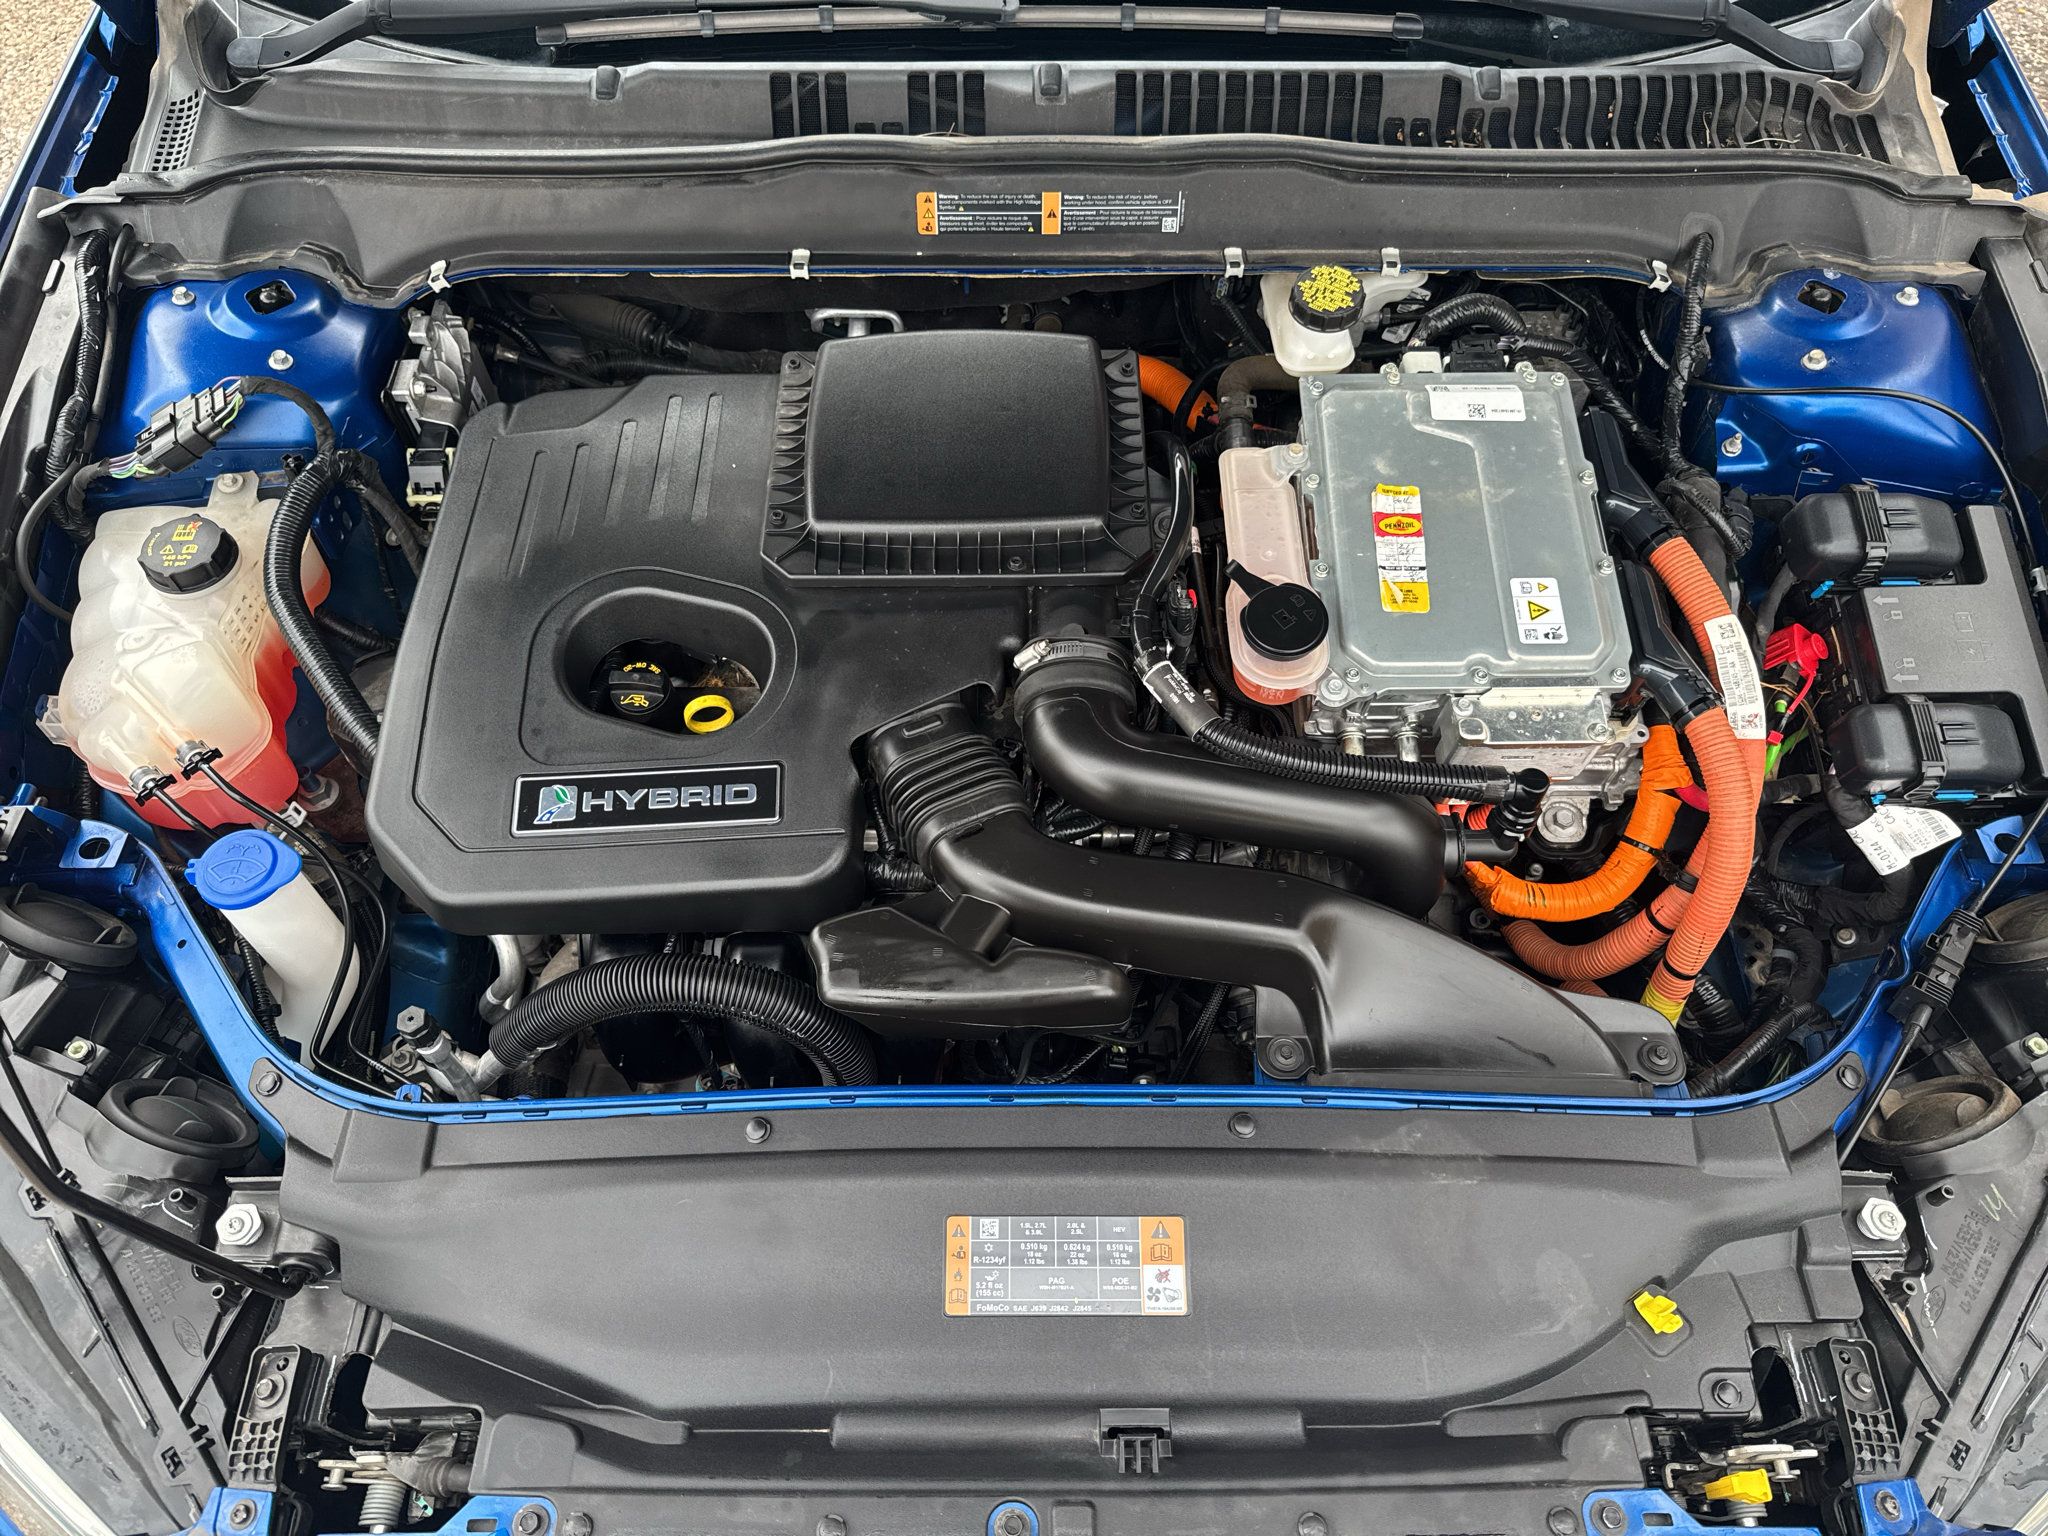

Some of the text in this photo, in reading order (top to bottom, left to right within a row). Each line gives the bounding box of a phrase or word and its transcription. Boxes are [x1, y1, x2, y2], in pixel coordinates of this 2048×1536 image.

[1384, 521, 1415, 530] PENNZOIL
[649, 664, 662, 674] SAE
[582, 783, 757, 812] HYBRID
[1040, 1243, 1048, 1251] kg
[1082, 1244, 1090, 1252] kg
[1125, 1244, 1132, 1252] kg
[973, 1256, 1006, 1265] R-1234yf
